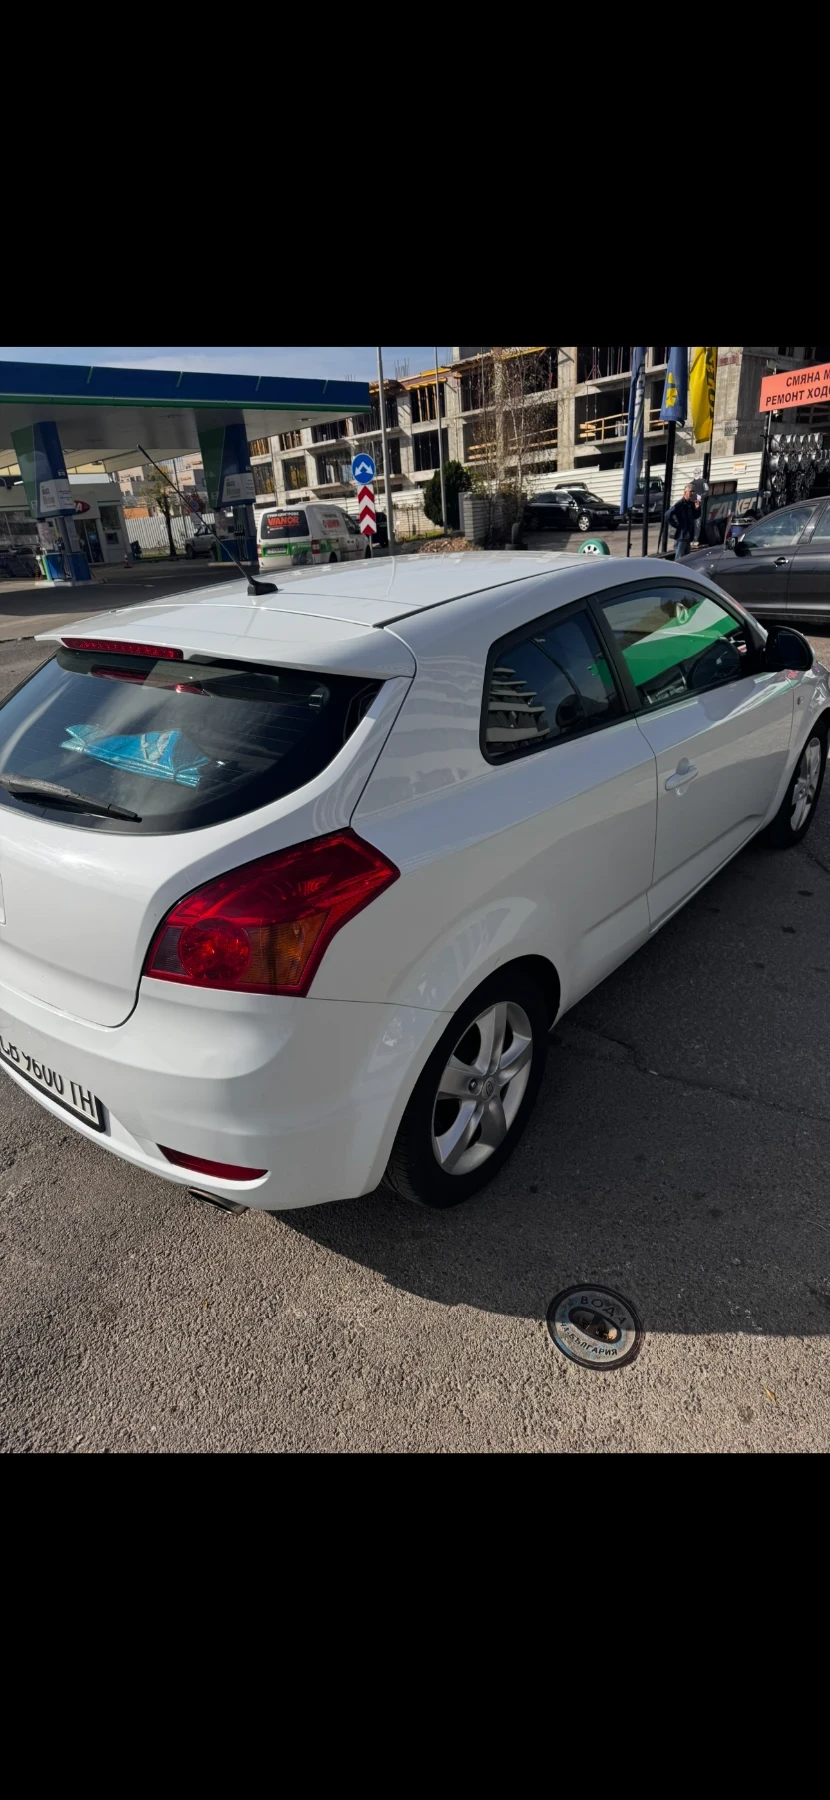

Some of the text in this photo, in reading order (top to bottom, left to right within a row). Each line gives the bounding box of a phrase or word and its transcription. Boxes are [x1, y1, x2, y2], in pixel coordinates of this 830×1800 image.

[786, 371, 820, 387] СМЯНА
[765, 390, 805, 406] РЕМОНТ
[580, 1296, 626, 1325] ВОДА
